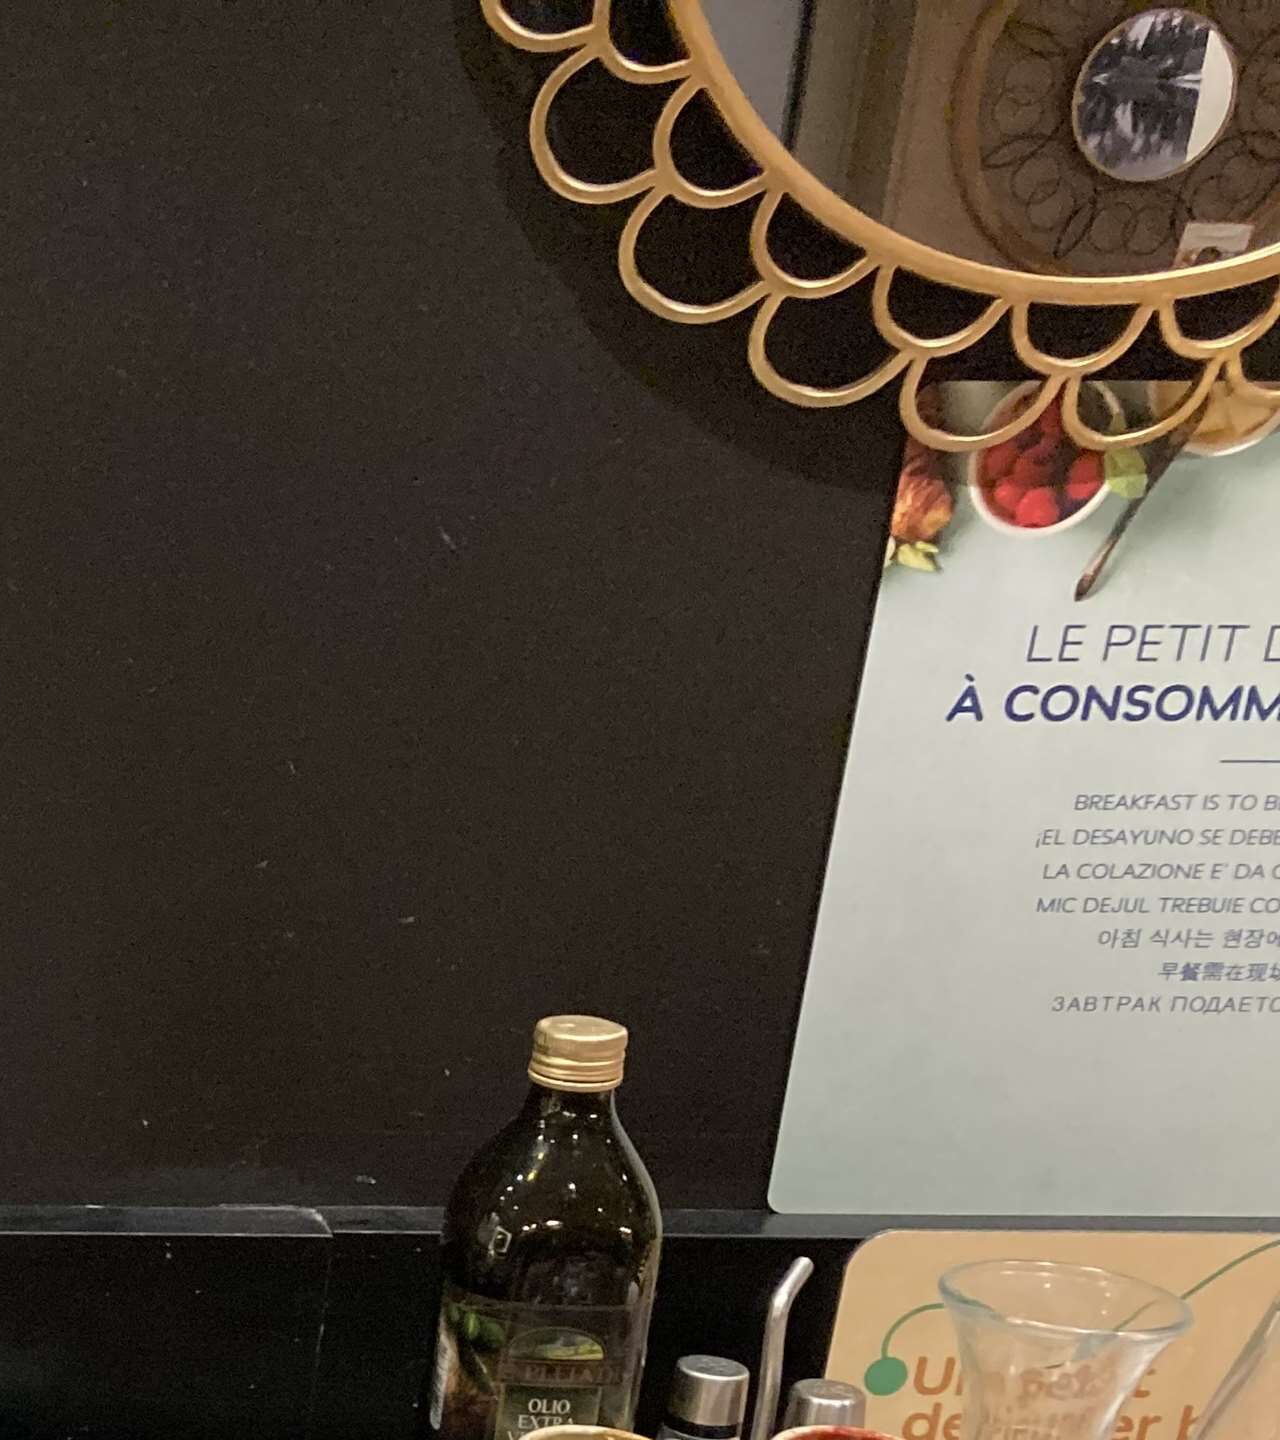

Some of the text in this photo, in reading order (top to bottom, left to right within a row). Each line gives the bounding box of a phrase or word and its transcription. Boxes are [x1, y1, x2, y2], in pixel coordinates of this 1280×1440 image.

[1026, 624, 1087, 662] LE
[1102, 624, 1251, 662] PETIT
[945, 673, 983, 722] À
[1073, 794, 1198, 811] BREAKFAST
[1202, 794, 1220, 811] IS
[1226, 794, 1258, 811] TO
[1072, 828, 1195, 846] DESAYUNO
[1199, 829, 1225, 846] SE
[1042, 863, 1071, 880] LA
[1076, 863, 1206, 880] COLAZIONE
[1234, 863, 1265, 880] DA
[1036, 897, 1077, 914] MIC
[1082, 897, 1151, 914] DEJUL
[1159, 897, 1245, 914] TREBUIE
[1098, 928, 1143, 949] 아침
[1149, 928, 1214, 949] 식사는
[1051, 996, 1162, 1013] ЗАВТРАК
[528, 1399, 571, 1414] OLIO
